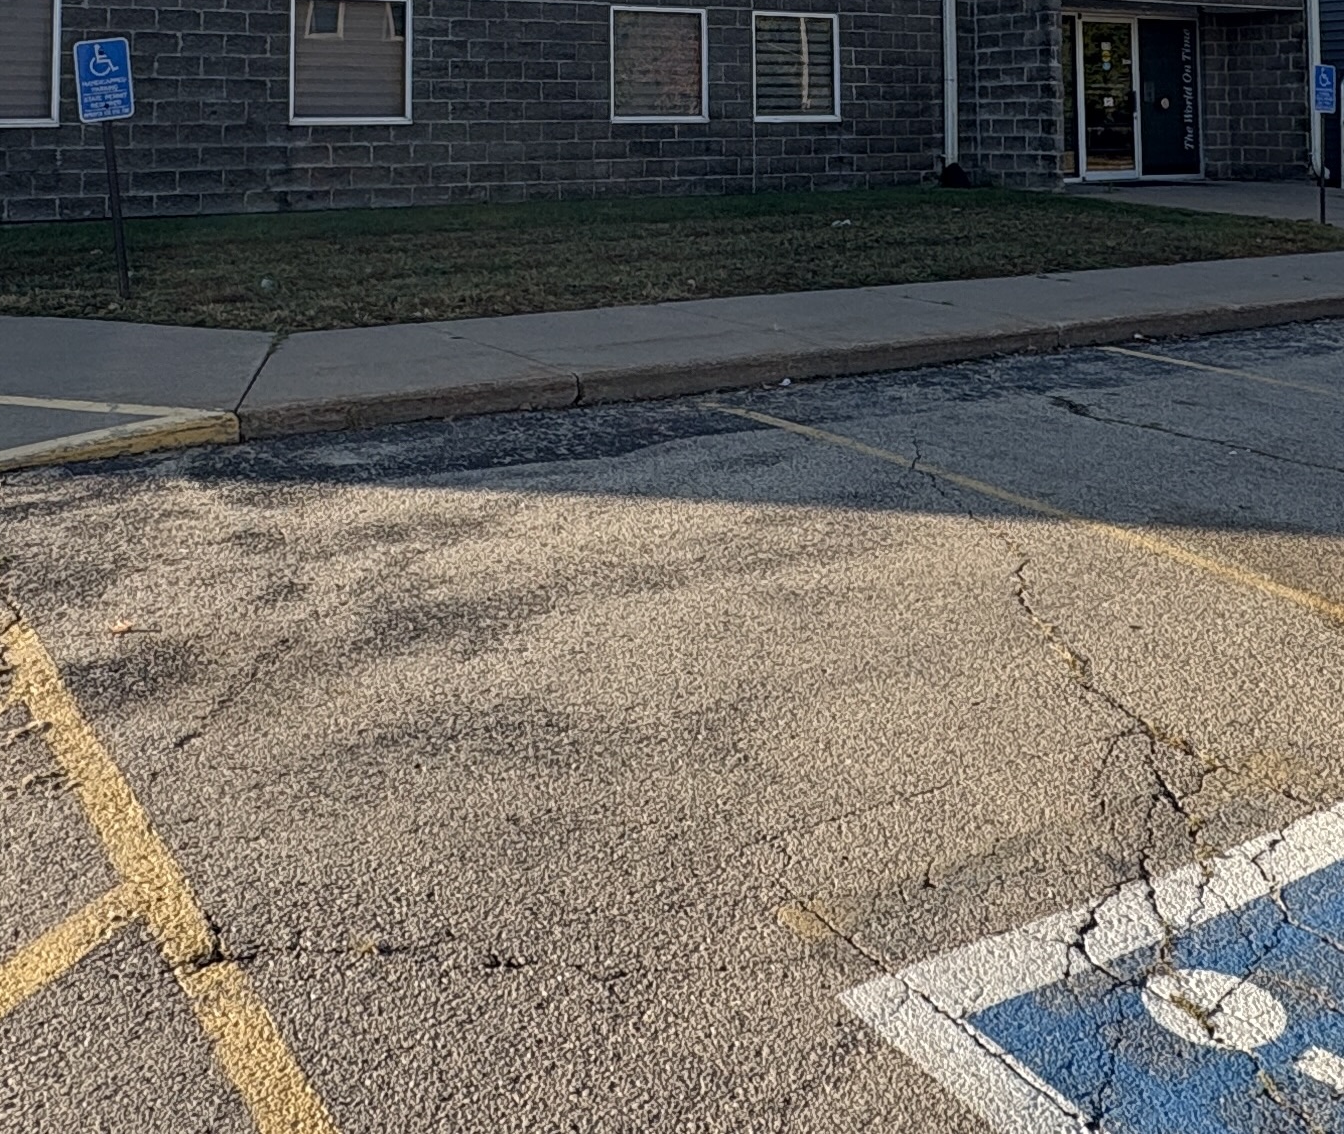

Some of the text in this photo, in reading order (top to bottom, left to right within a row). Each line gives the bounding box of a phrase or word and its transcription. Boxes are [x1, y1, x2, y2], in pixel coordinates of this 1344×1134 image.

[1181, 28, 1195, 150] The World On Time
